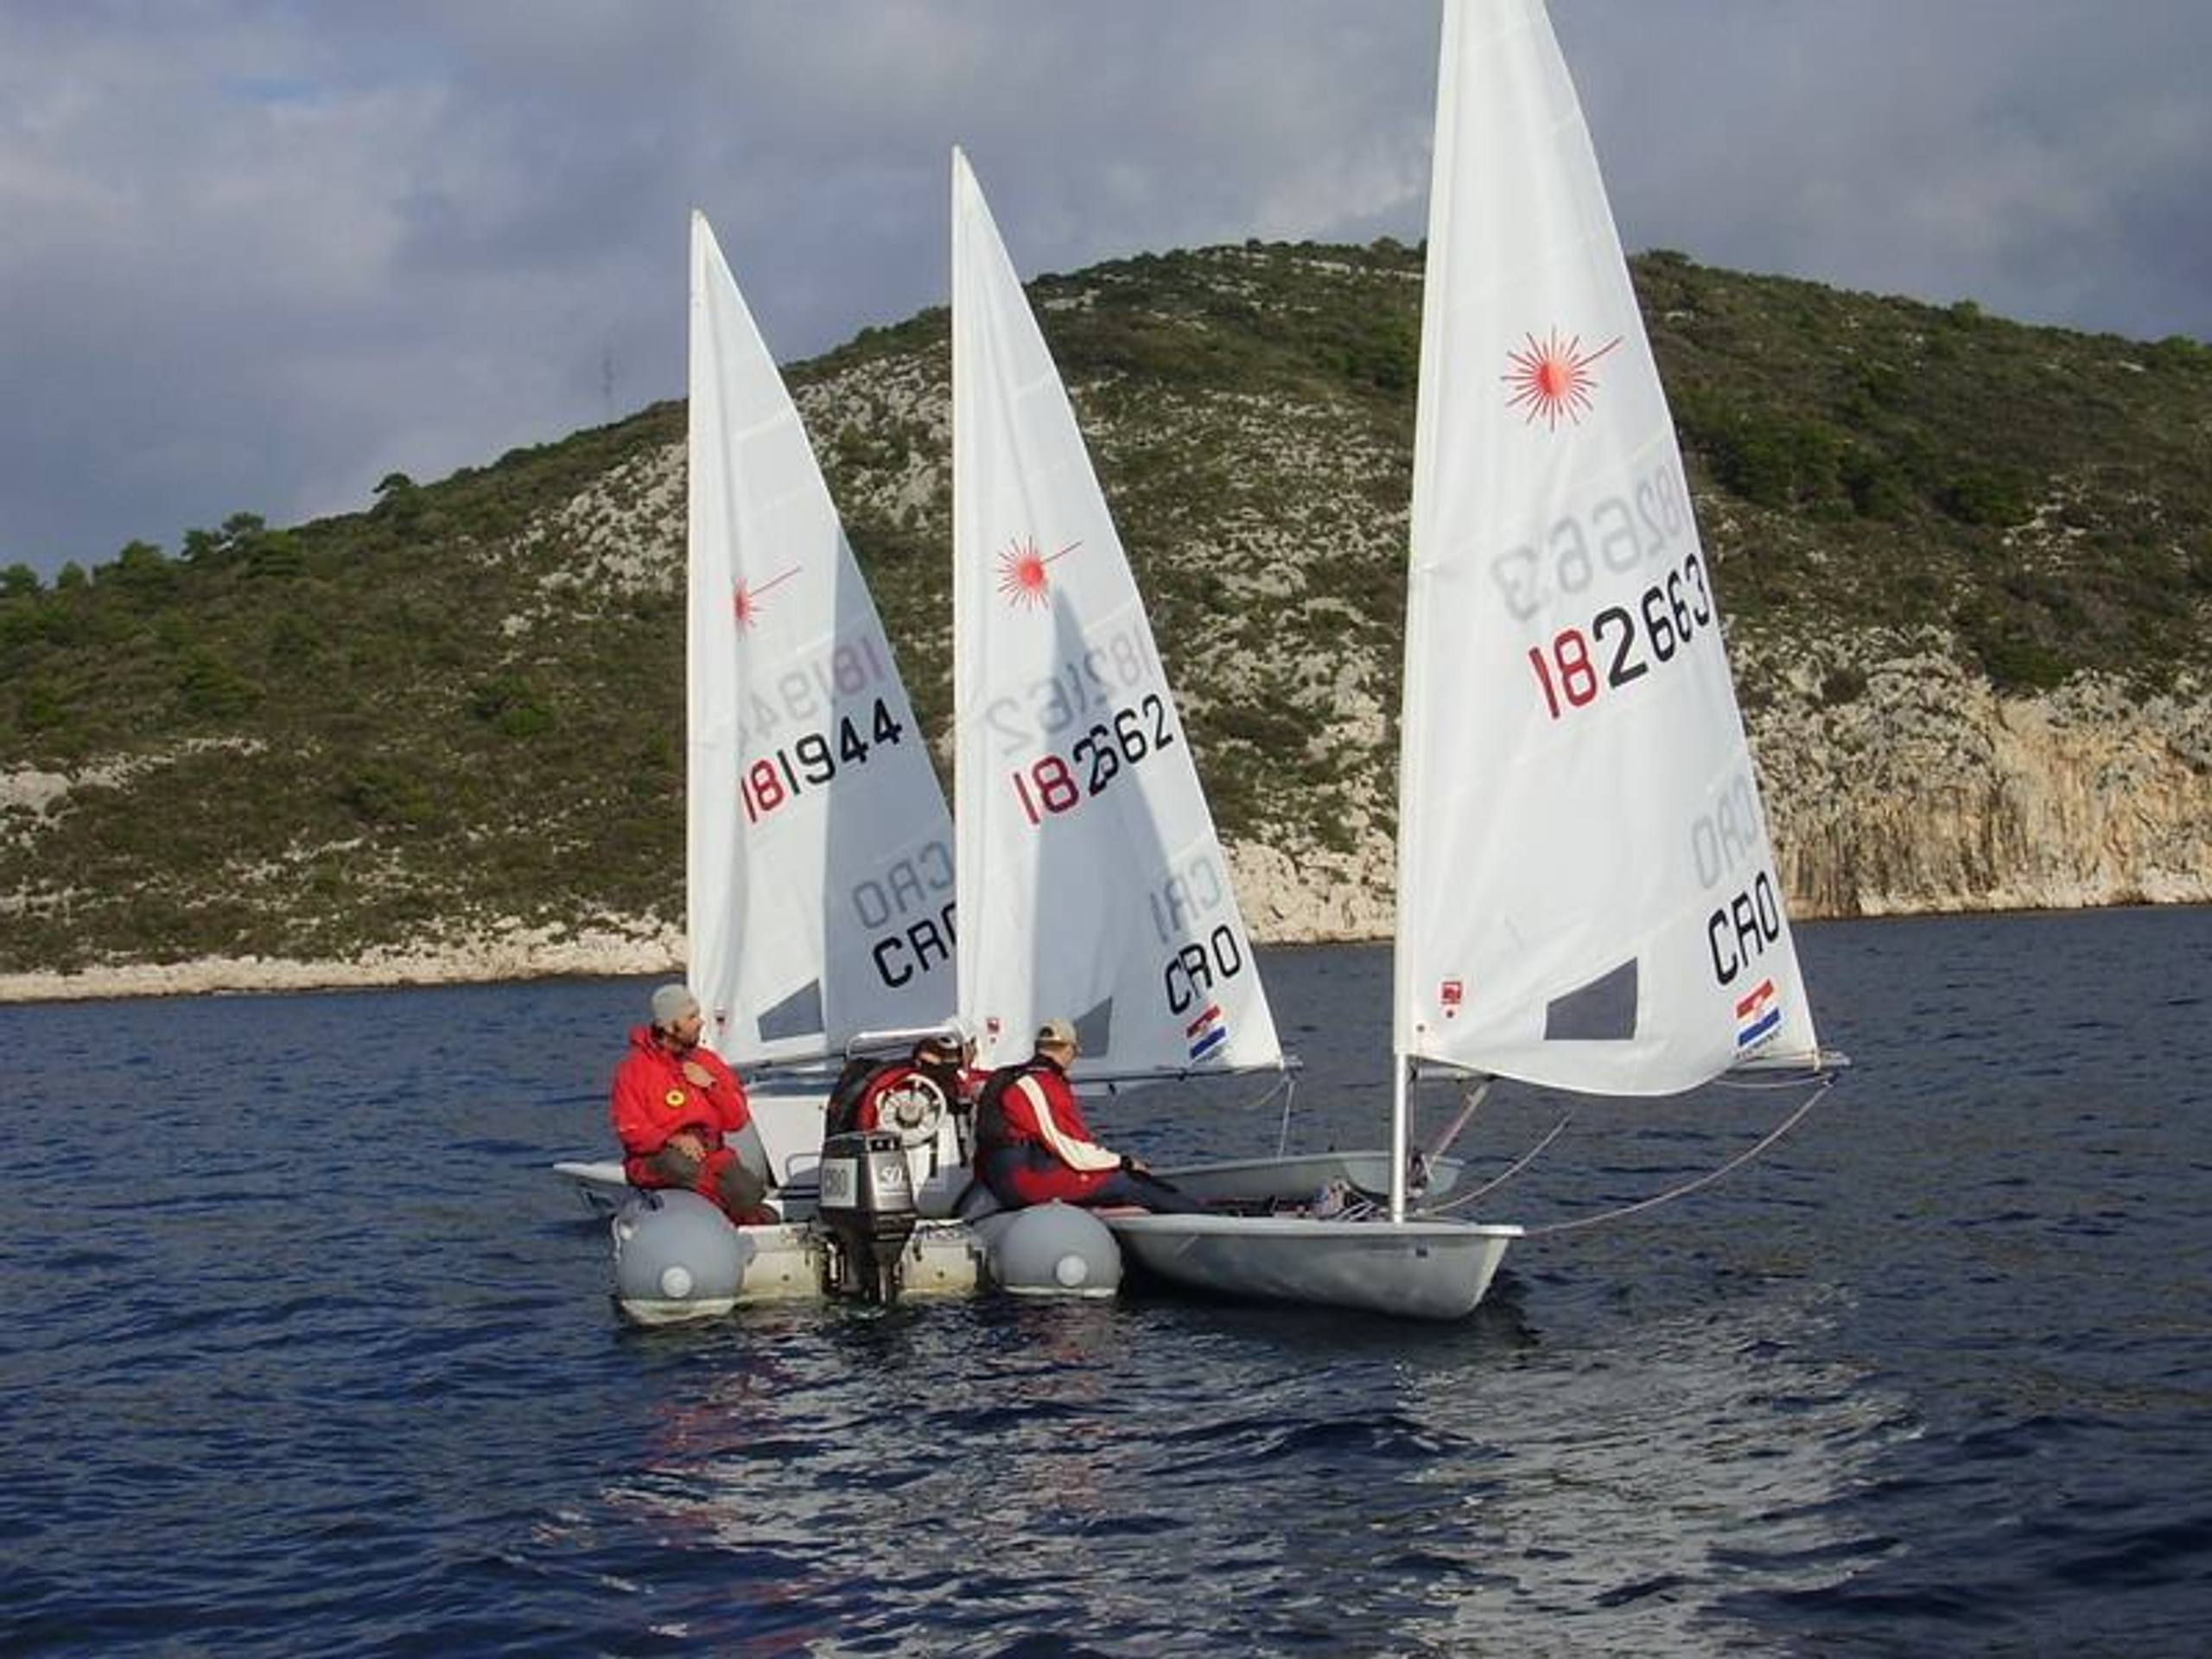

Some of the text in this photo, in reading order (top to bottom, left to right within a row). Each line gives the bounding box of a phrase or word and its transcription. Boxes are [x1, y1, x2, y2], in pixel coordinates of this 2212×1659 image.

[1528, 553, 1710, 719] 182663
[741, 696, 902, 823] 181944
[1013, 694, 1173, 825] 182662
[1165, 924, 1243, 1016] CRO
[1708, 870, 1780, 986] CRO
